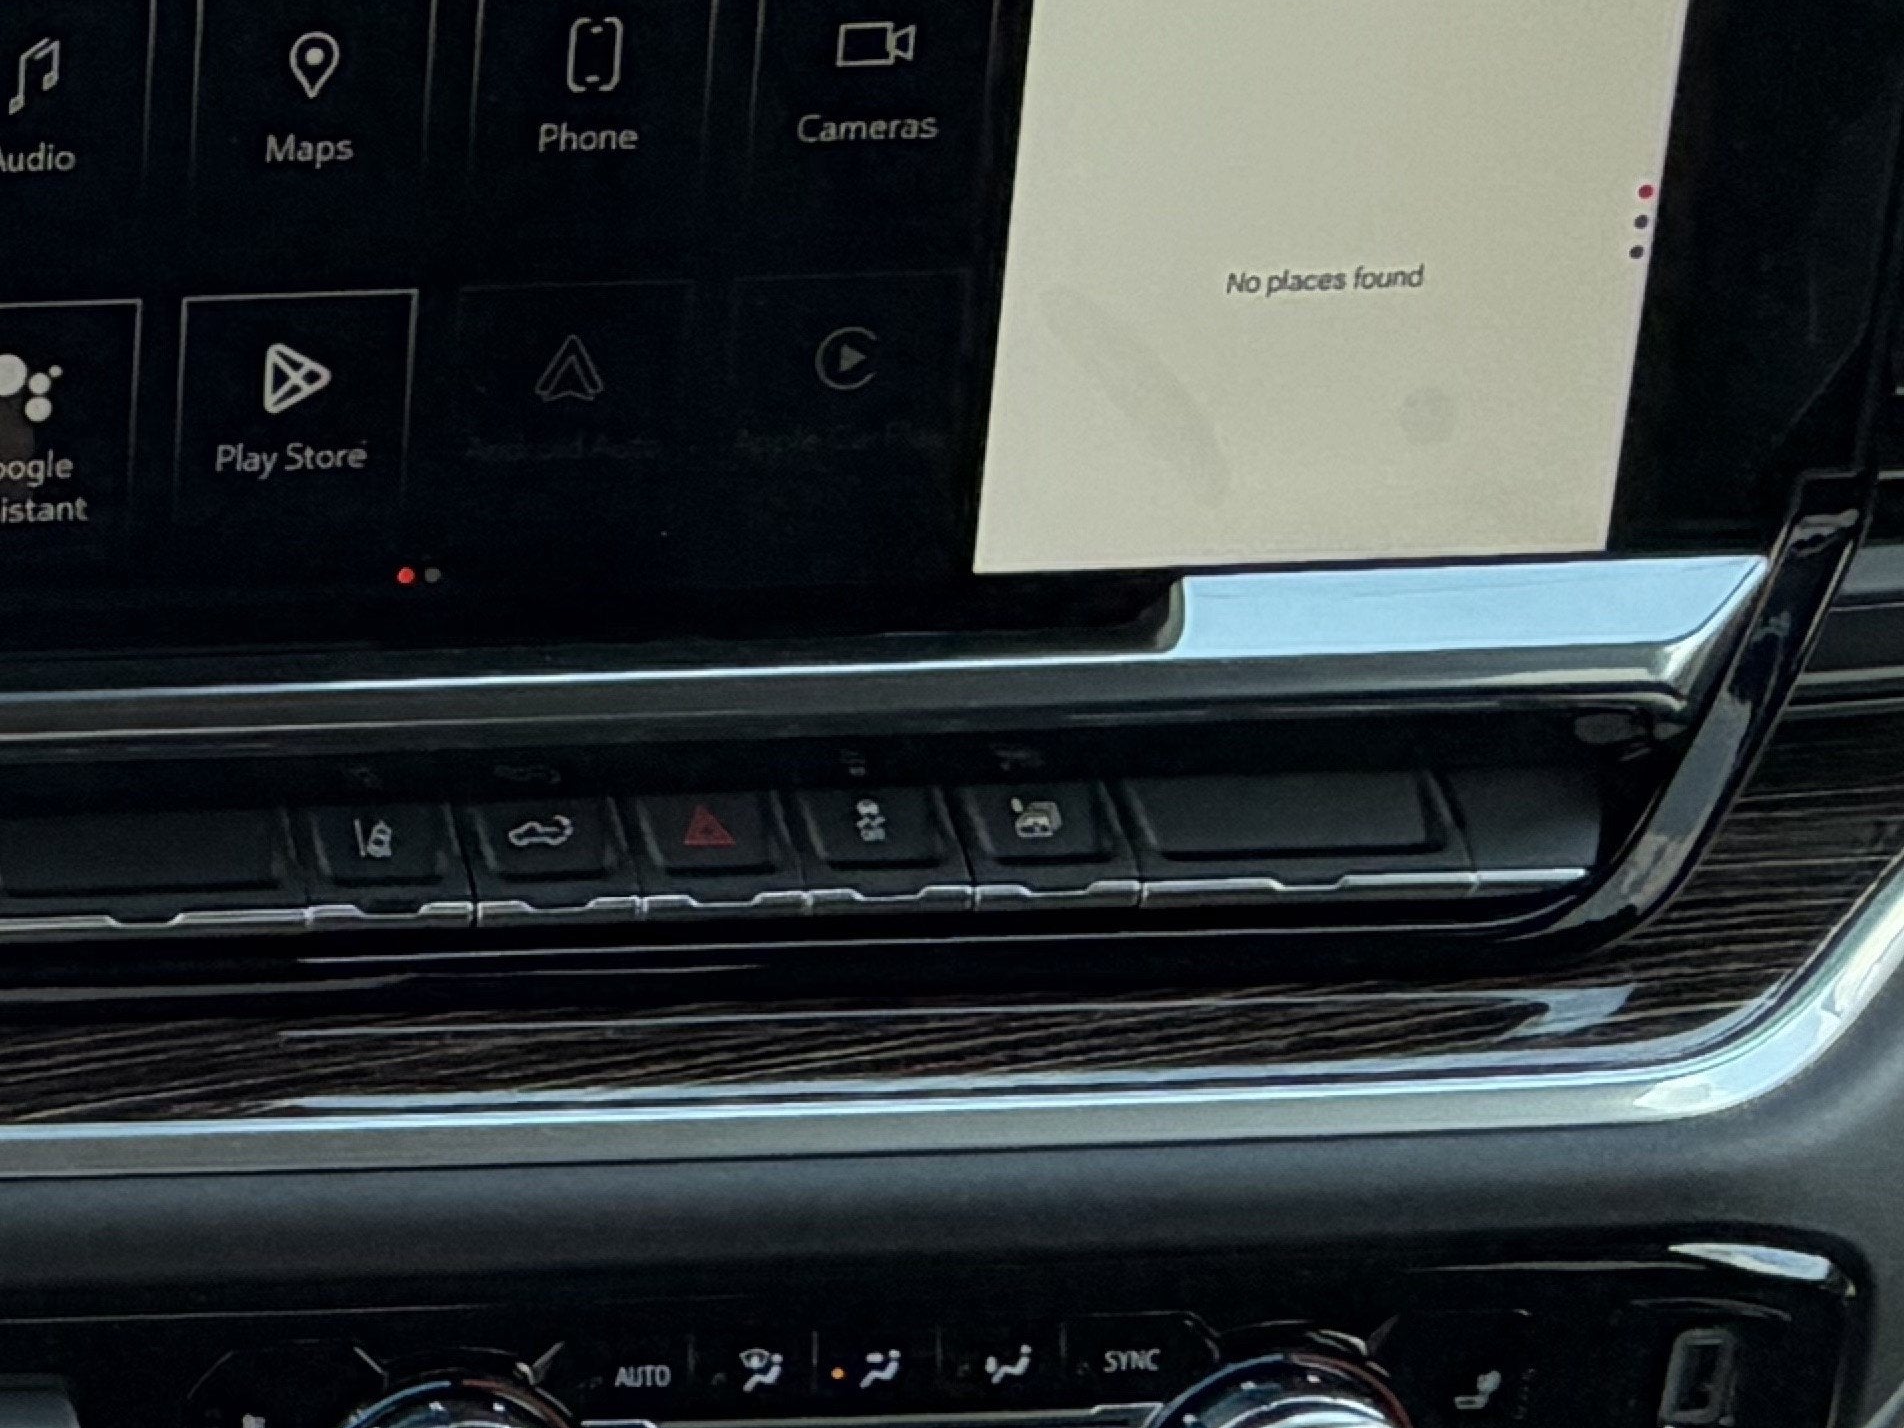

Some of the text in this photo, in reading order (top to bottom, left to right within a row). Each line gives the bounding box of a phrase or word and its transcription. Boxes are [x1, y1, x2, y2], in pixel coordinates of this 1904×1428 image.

[539, 123, 637, 151] Phone
[798, 115, 937, 142] Cameras
[266, 133, 353, 169] Maps
[1227, 263, 1424, 297] No places found
[216, 443, 367, 479] Play Store
[1105, 1349, 1160, 1372] SYNC
[615, 1365, 671, 1387] AUTO
